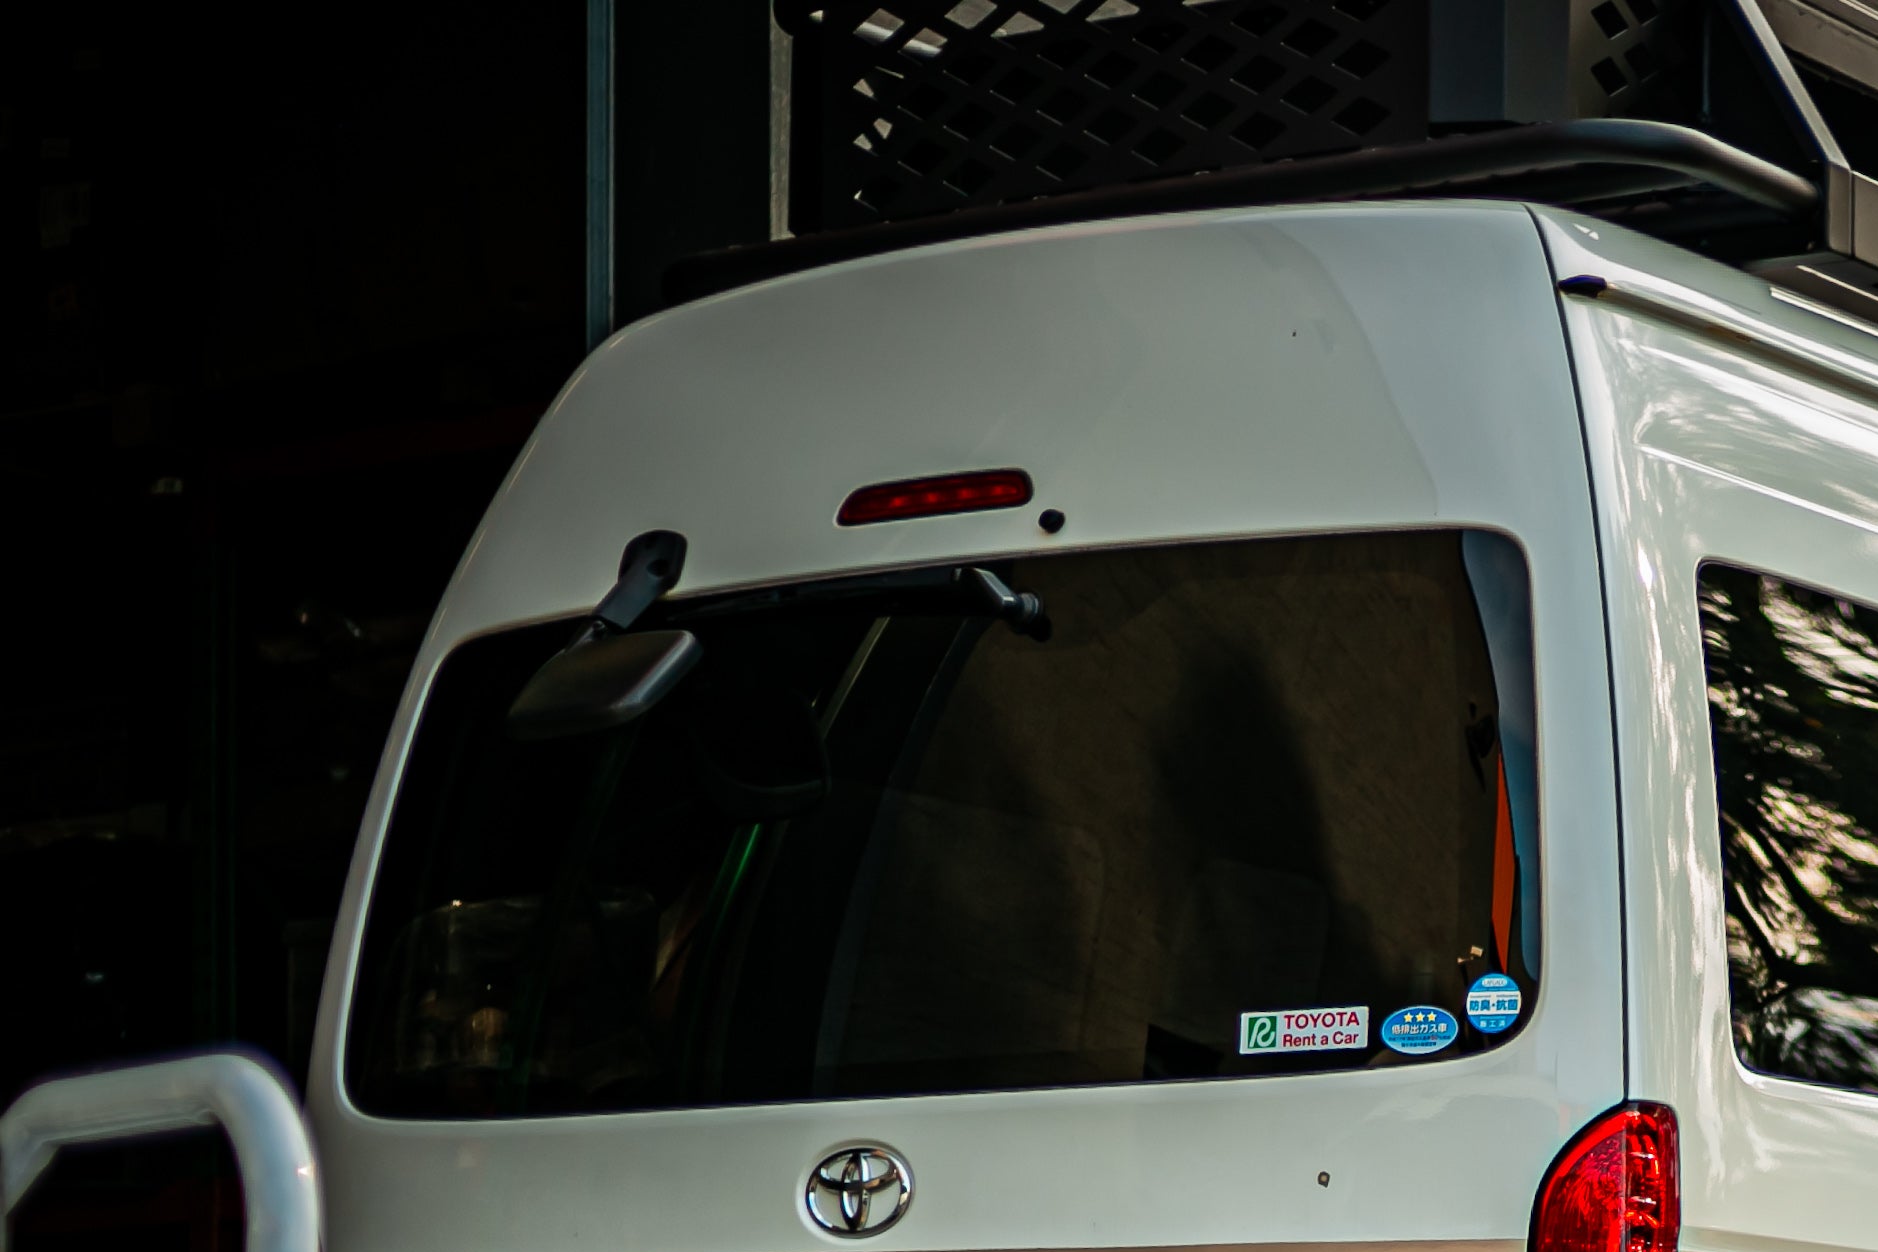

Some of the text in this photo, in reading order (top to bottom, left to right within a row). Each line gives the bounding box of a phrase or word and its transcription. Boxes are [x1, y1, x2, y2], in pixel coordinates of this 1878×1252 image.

[1284, 1012, 1360, 1030] TOYOTA
[1283, 1031, 1359, 1048] Rent a Car
